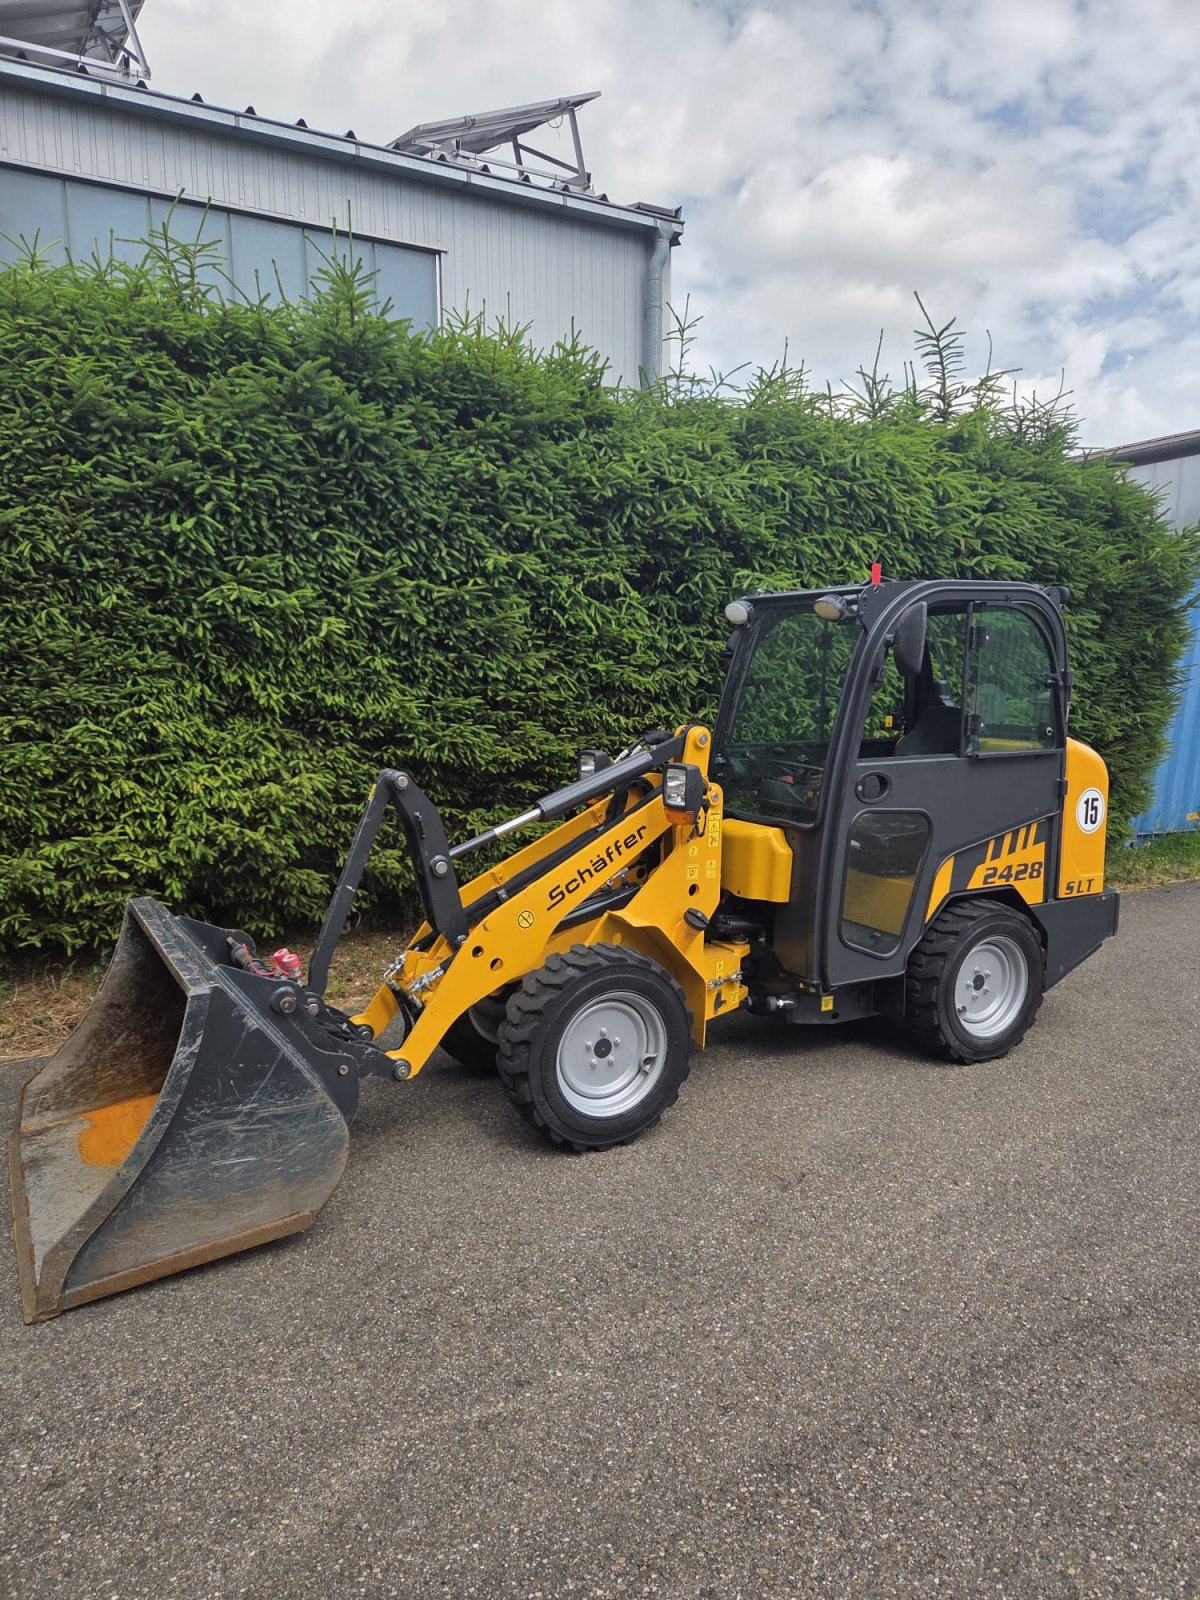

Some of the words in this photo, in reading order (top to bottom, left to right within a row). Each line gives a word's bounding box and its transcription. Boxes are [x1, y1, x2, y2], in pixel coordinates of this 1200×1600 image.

[1084, 798, 1099, 825] 15
[547, 825, 647, 911] Schäffer
[983, 861, 1043, 885] 2428
[1064, 879, 1094, 895] SLT
